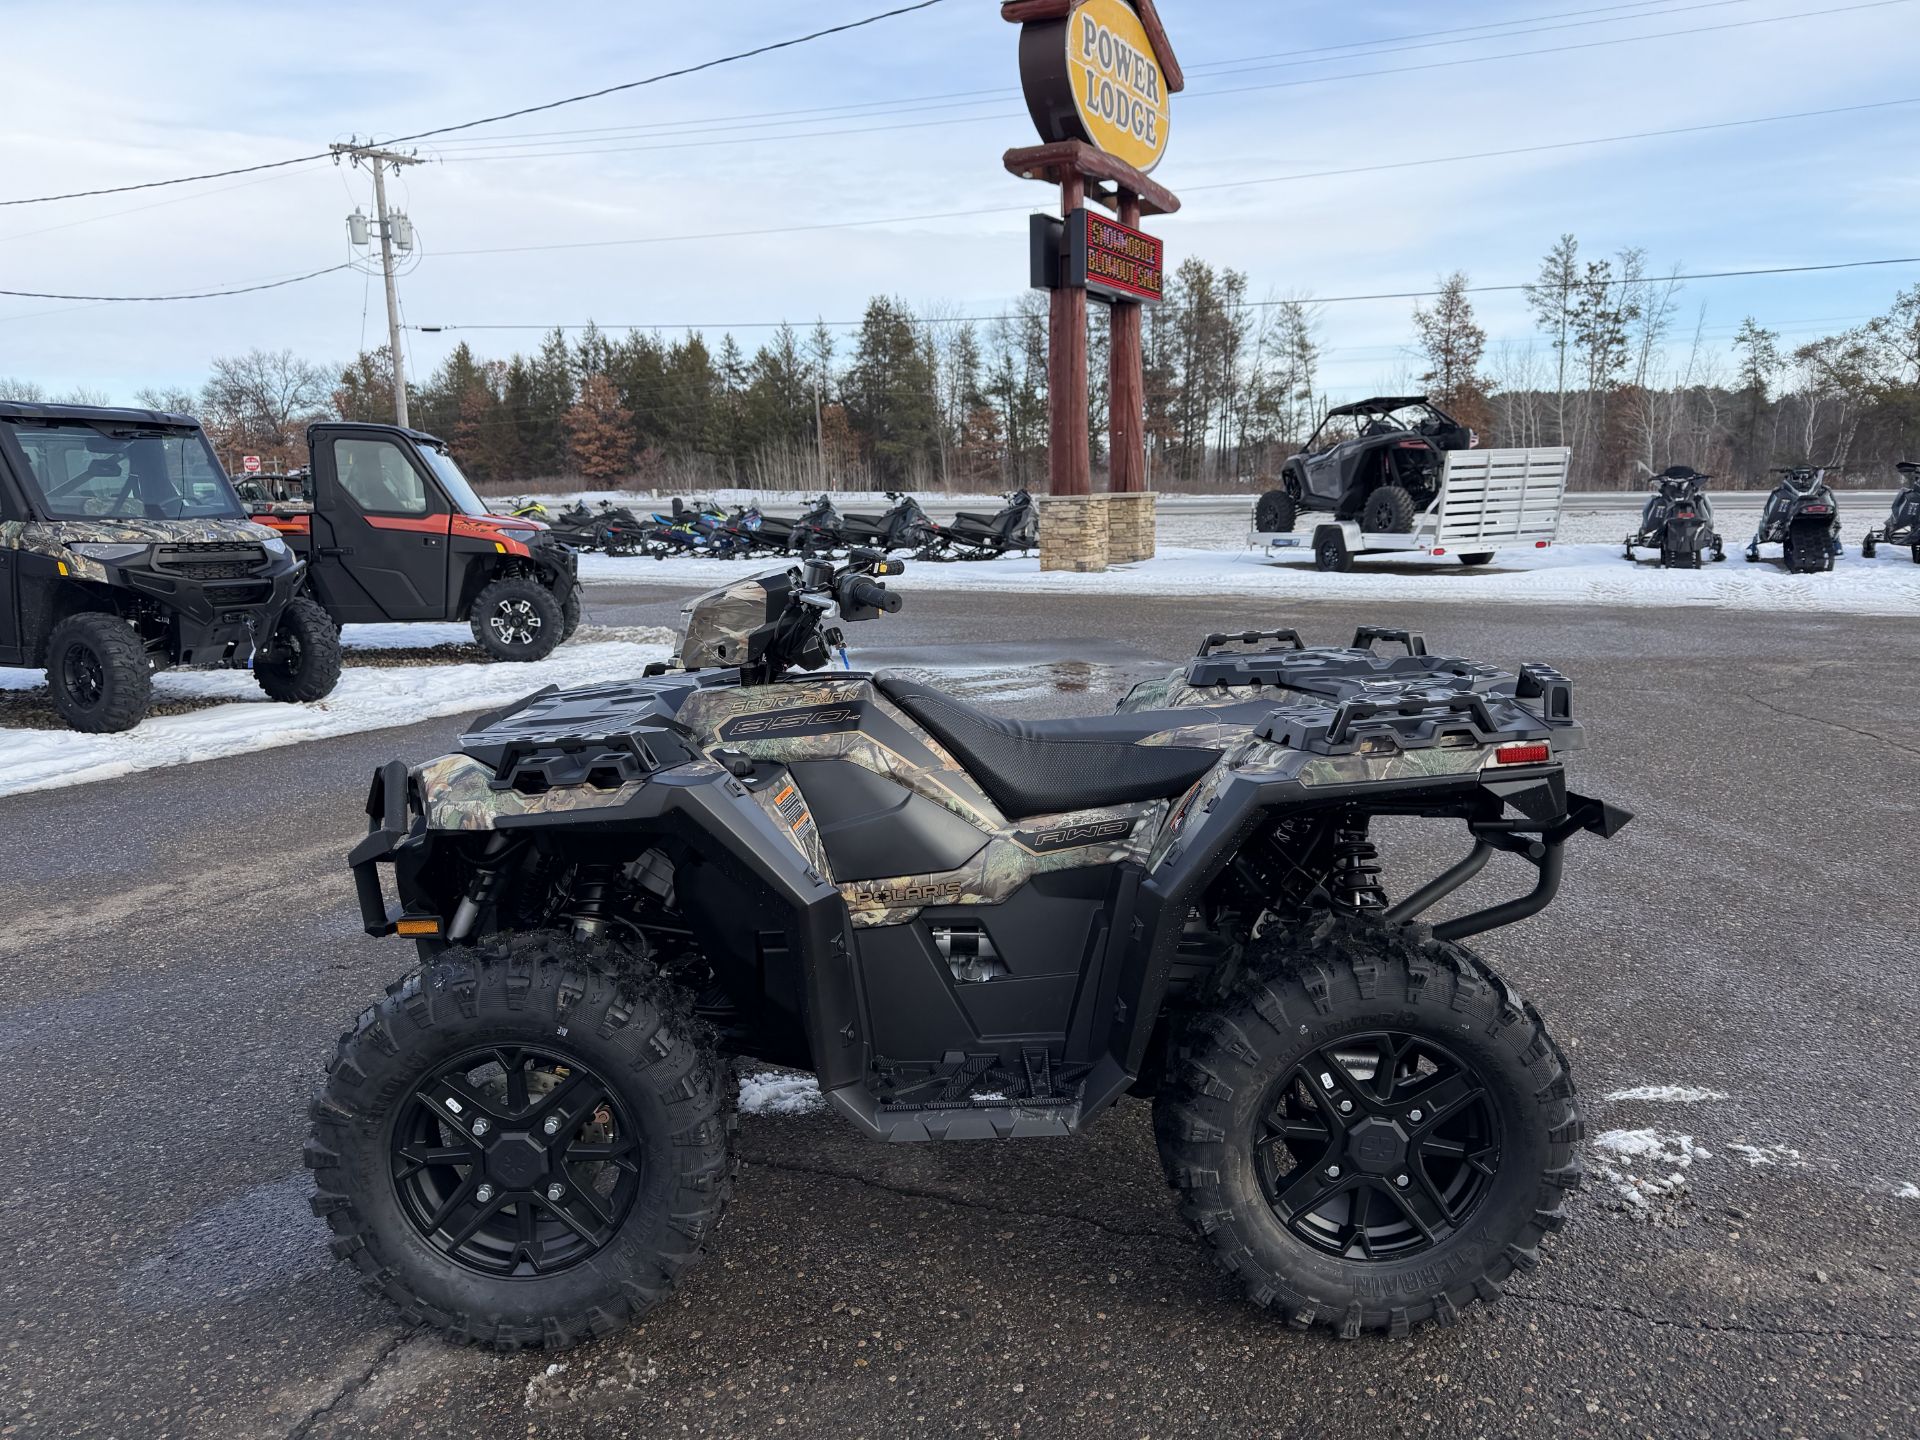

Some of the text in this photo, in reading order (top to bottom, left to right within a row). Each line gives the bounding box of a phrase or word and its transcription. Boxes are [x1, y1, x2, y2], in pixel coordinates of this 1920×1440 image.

[1083, 15, 1159, 104] POWER
[1086, 69, 1157, 147] LODGE
[1092, 222, 1156, 264] SNOWMOBILE
[1087, 248, 1161, 291] BLOWOUT SALE
[730, 690, 859, 713] SPORTSMAN
[729, 709, 851, 735] 850
[1034, 821, 1129, 846] AWD
[855, 881, 962, 906] POLARIS
